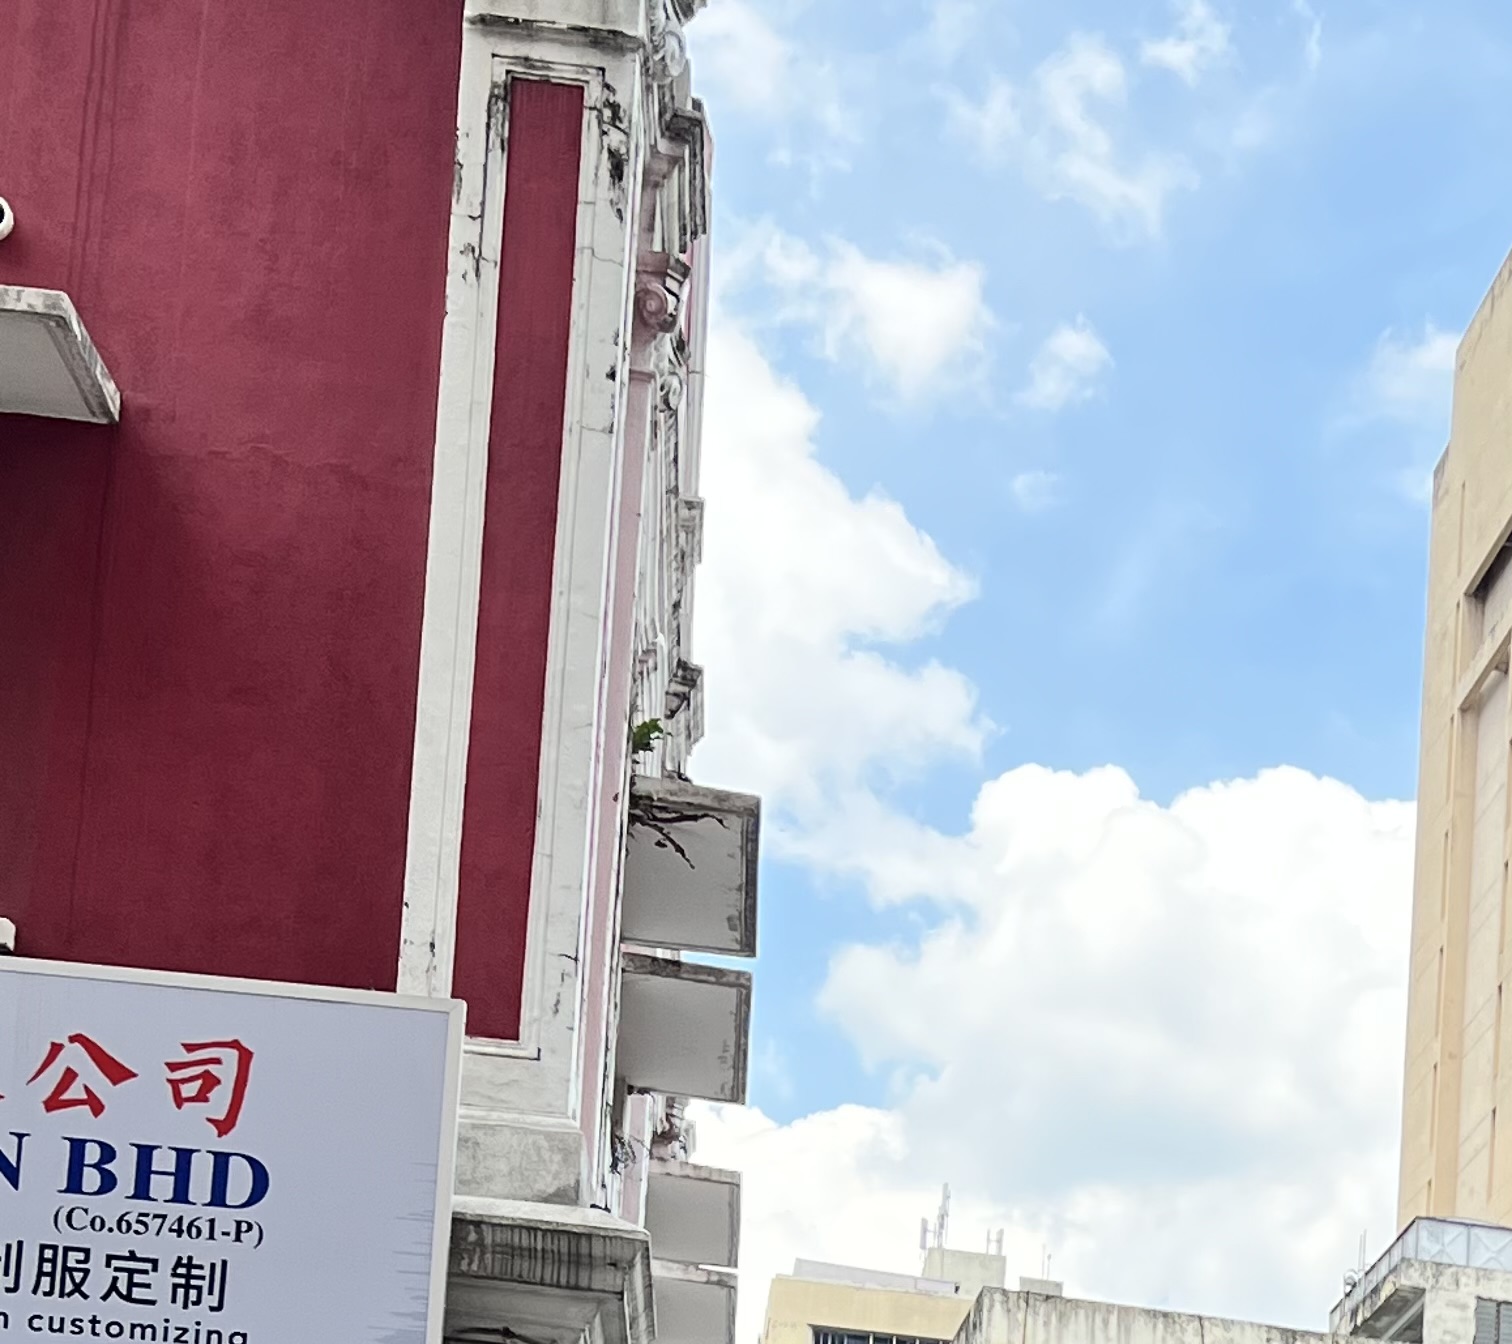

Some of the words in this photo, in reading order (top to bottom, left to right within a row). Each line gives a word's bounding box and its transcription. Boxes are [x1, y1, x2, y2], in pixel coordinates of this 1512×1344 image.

[0, 1033, 255, 1138] 公司
[57, 1136, 271, 1209] BHD
[53, 1205, 264, 1249] (Co.657461-P)
